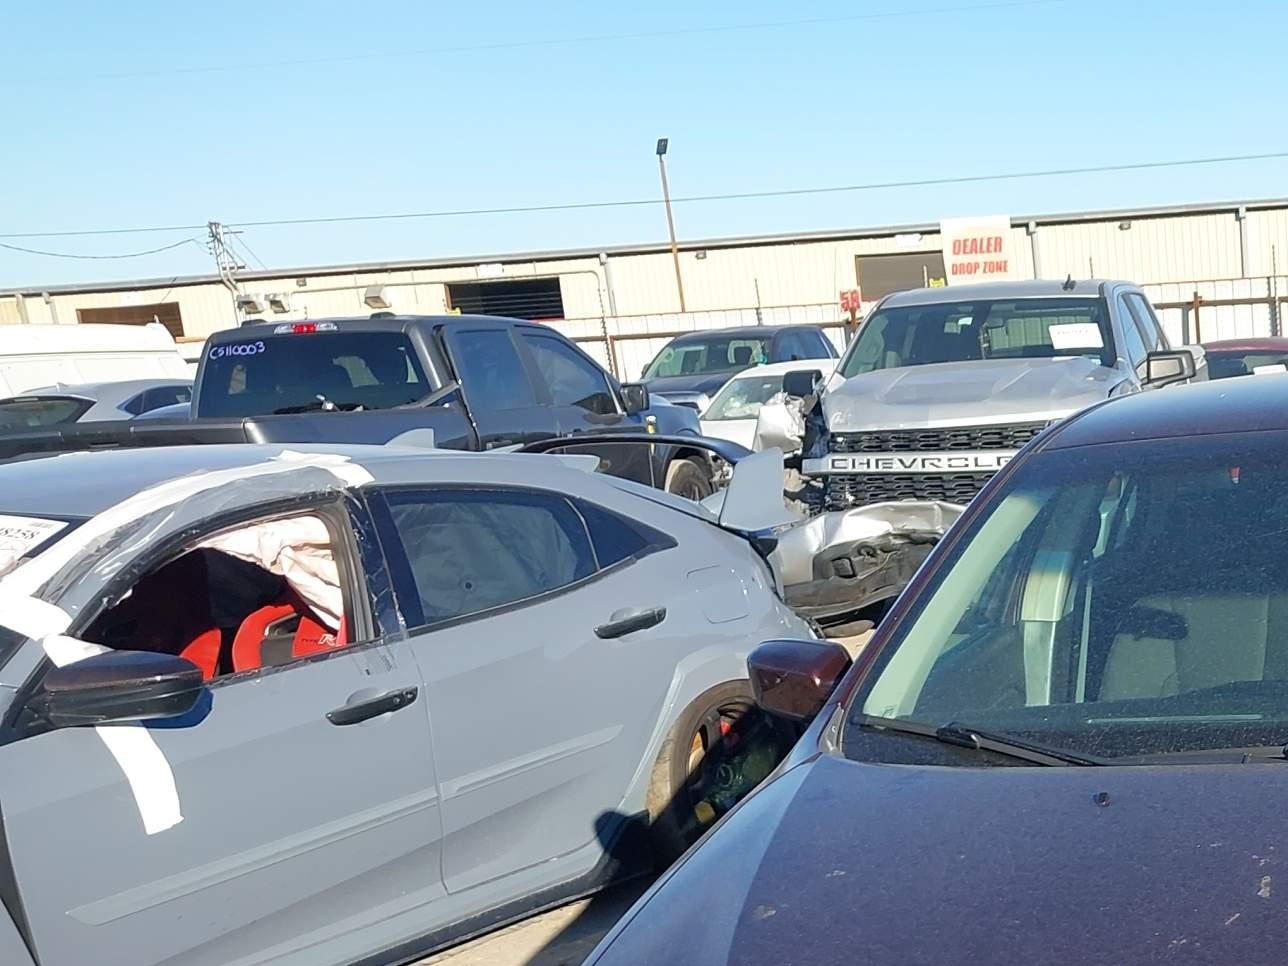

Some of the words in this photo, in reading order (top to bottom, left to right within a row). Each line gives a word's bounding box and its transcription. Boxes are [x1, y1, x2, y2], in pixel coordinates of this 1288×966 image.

[952, 236, 1002, 255] DEALER
[951, 262, 980, 275] DROP
[982, 260, 1009, 274] ZONE
